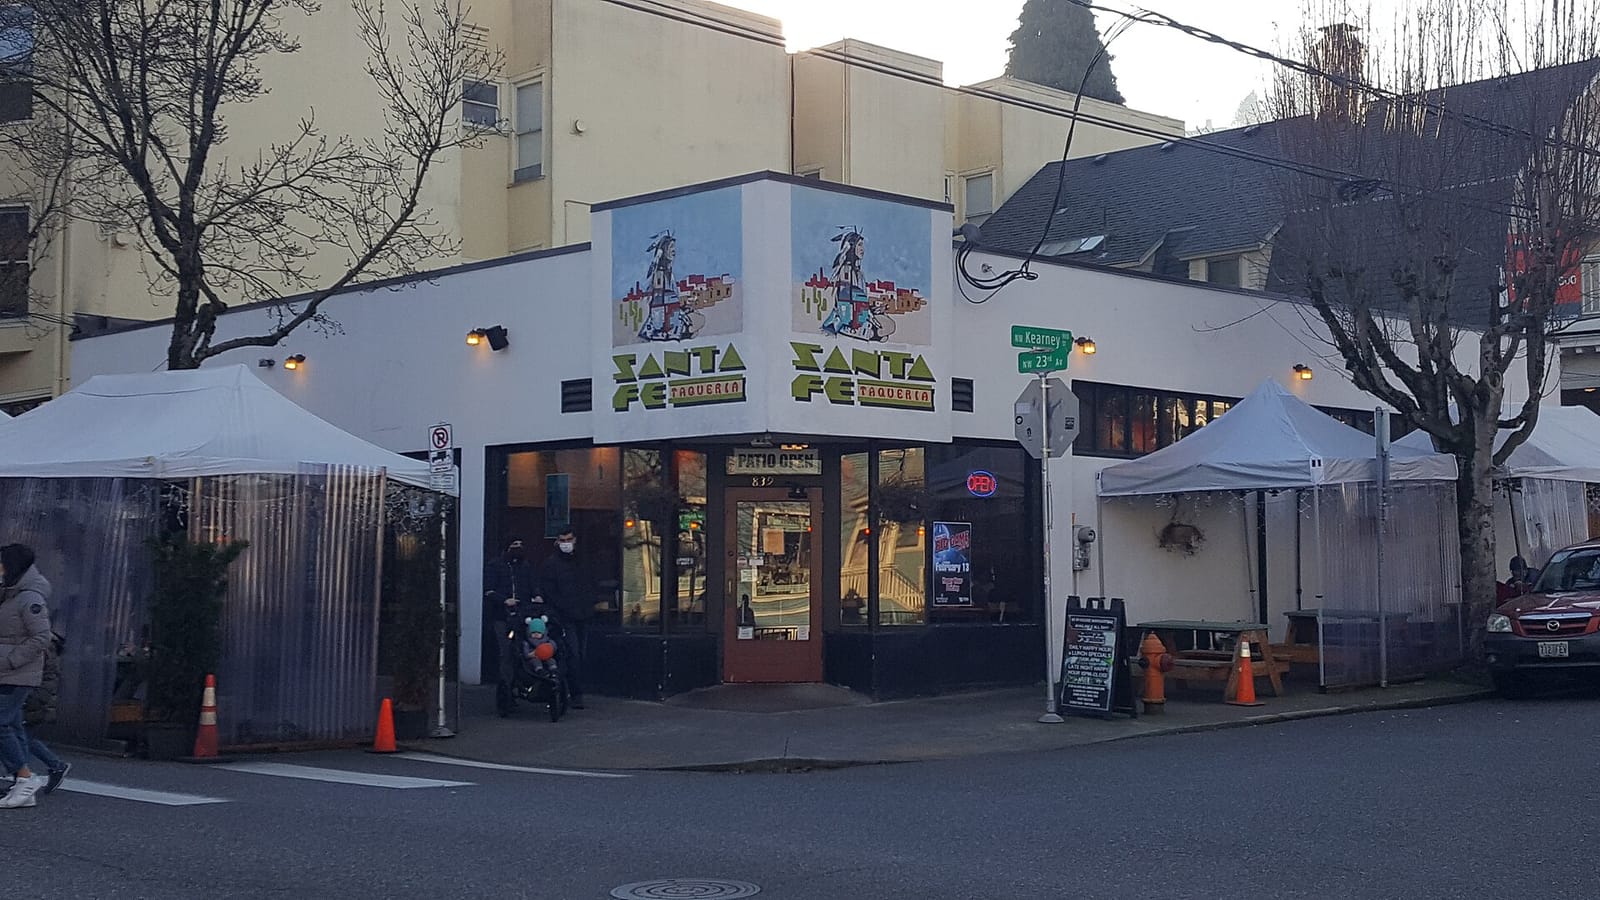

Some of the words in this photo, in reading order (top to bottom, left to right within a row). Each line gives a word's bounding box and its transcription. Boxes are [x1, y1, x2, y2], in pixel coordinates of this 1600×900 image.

[1025, 331, 1061, 349] Kearney
[612, 342, 746, 384] SANTA
[790, 342, 936, 382] SANTA
[1036, 355, 1052, 368] 23rd
[612, 382, 667, 412] FE
[671, 381, 739, 399] TAQUERIA
[791, 374, 855, 406] FE
[859, 385, 929, 402] TAQUERIA
[737, 453, 776, 468] PATIO
[779, 453, 815, 468] OPEN
[950, 531, 970, 548] GAME
[935, 562, 961, 573] February
[962, 562, 970, 572] 13
